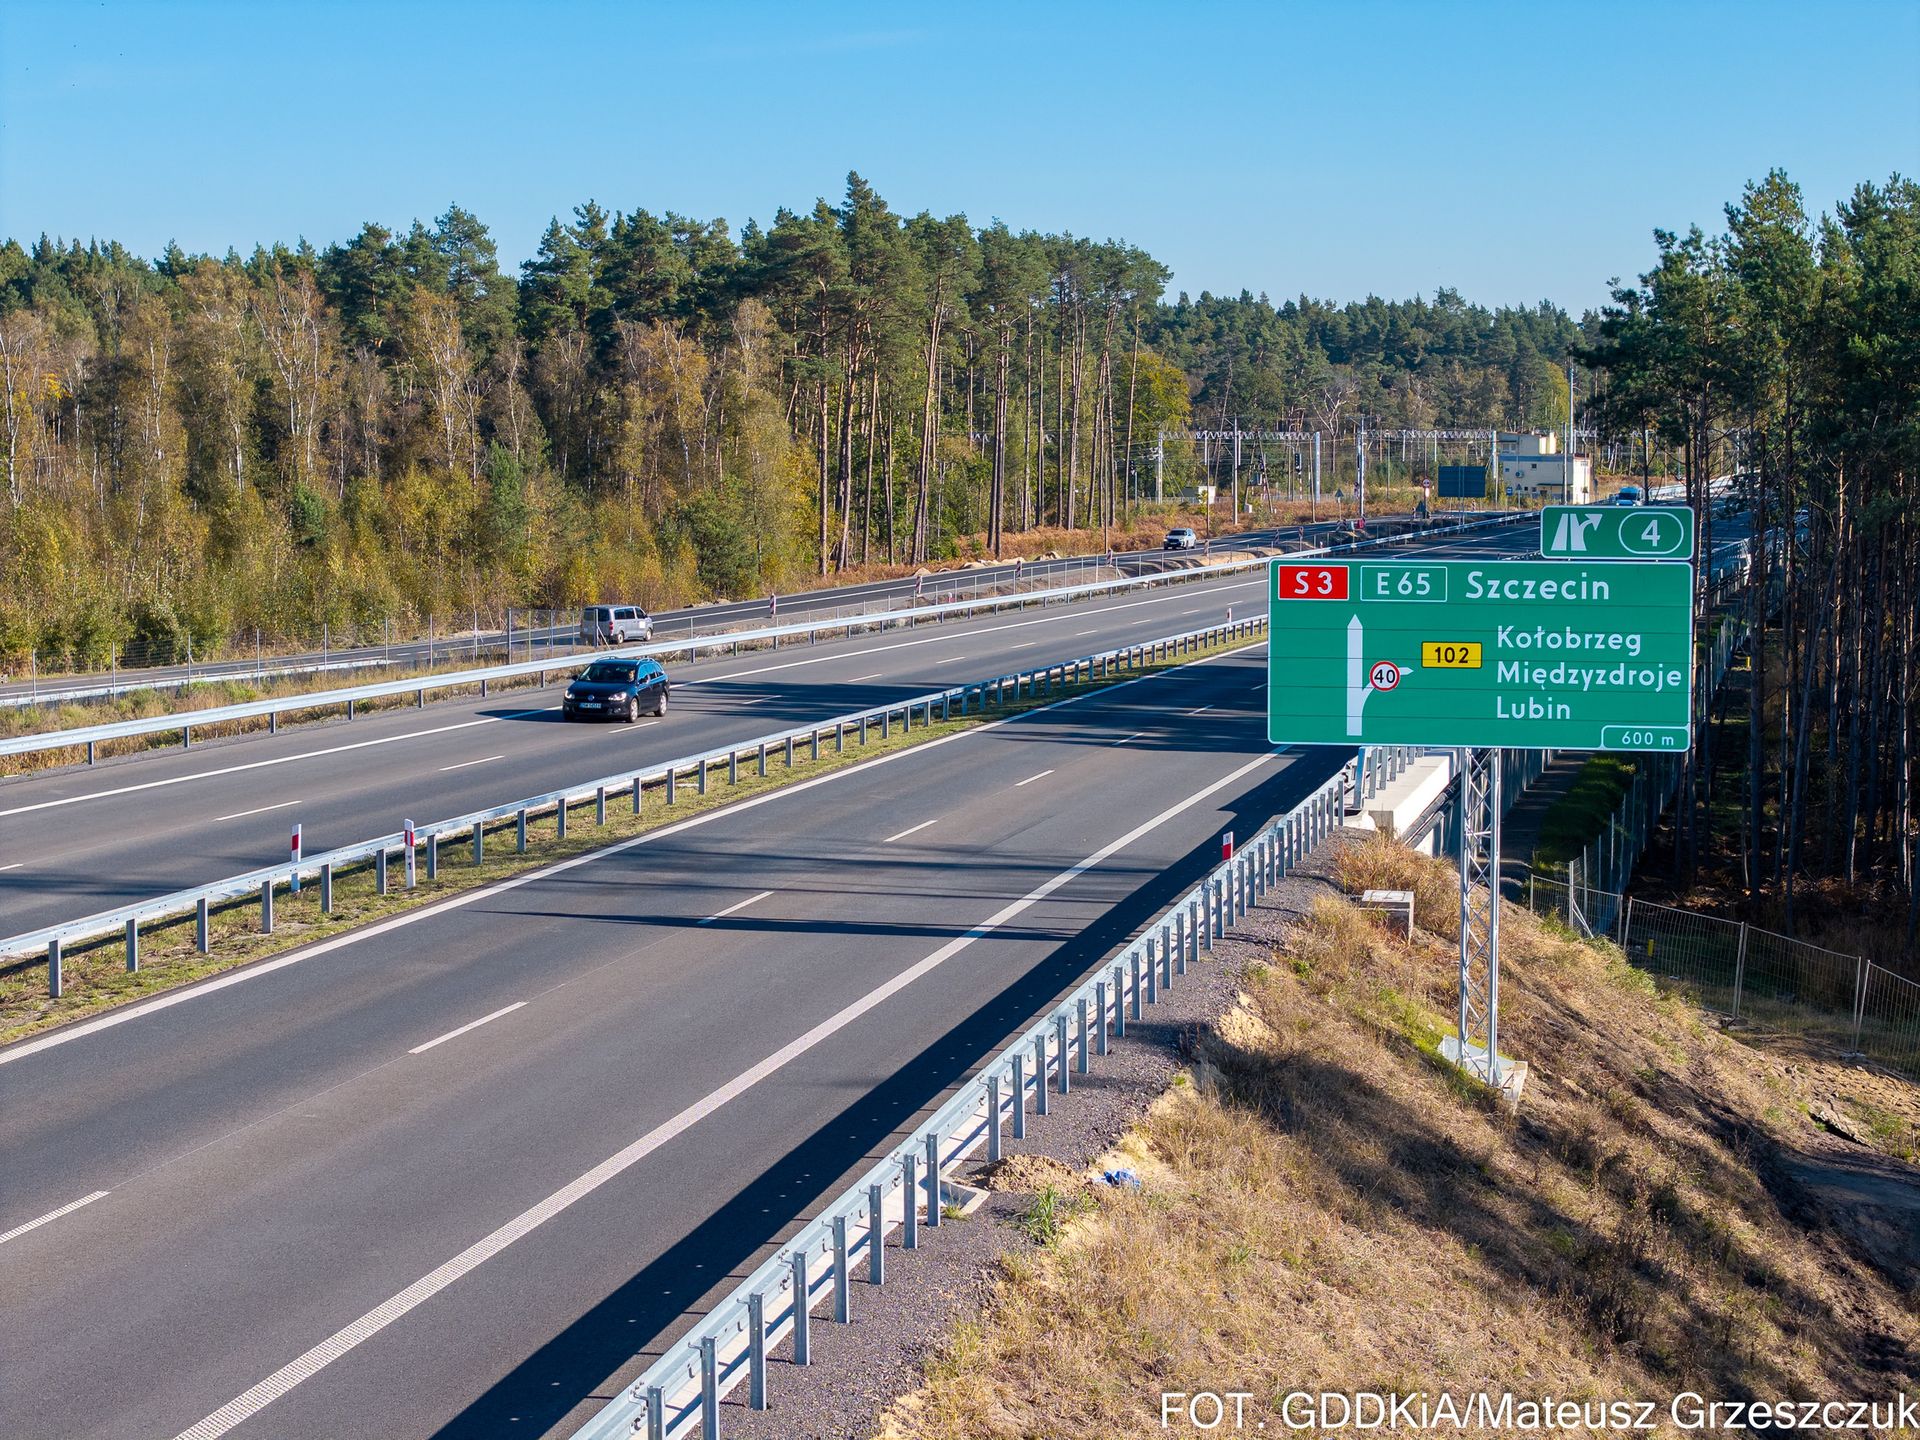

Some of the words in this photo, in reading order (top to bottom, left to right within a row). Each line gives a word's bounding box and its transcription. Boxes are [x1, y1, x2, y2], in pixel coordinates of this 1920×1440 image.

[1641, 519, 1661, 547] 4
[1465, 571, 1610, 600] Szczecin
[1497, 625, 1642, 657] Kołobrzeg
[1434, 646, 1469, 663] 102
[1374, 669, 1396, 684] 40
[1497, 660, 1682, 693] Międzyzdroje
[1497, 696, 1571, 719] Lubin
[1621, 731, 1653, 745] 600
[1661, 736, 1674, 746] m
